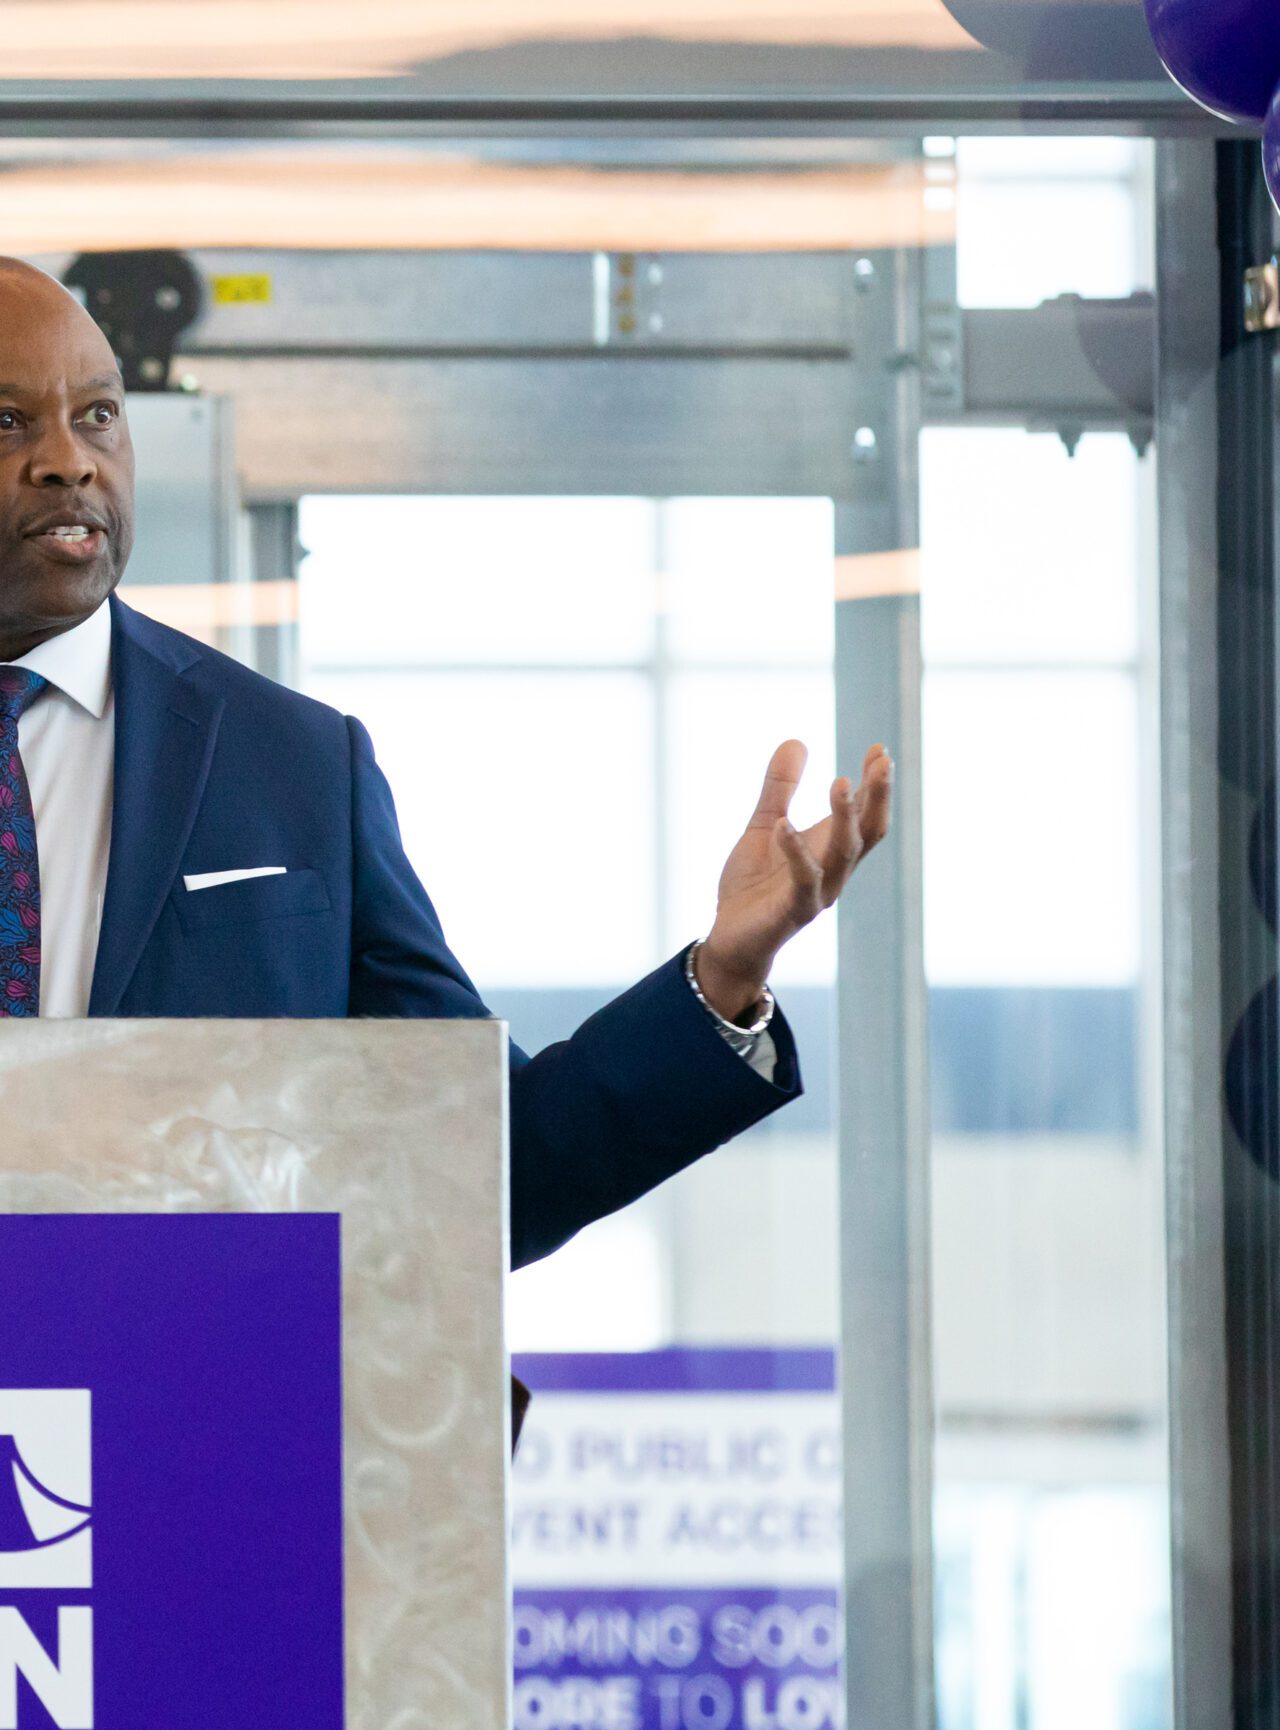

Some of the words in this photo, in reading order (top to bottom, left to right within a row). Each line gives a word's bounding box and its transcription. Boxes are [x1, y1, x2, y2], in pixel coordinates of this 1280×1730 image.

[568, 1432, 784, 1479] PUBLIC
[667, 1502, 839, 1549] ACCE
[652, 1676, 733, 1730] TO
